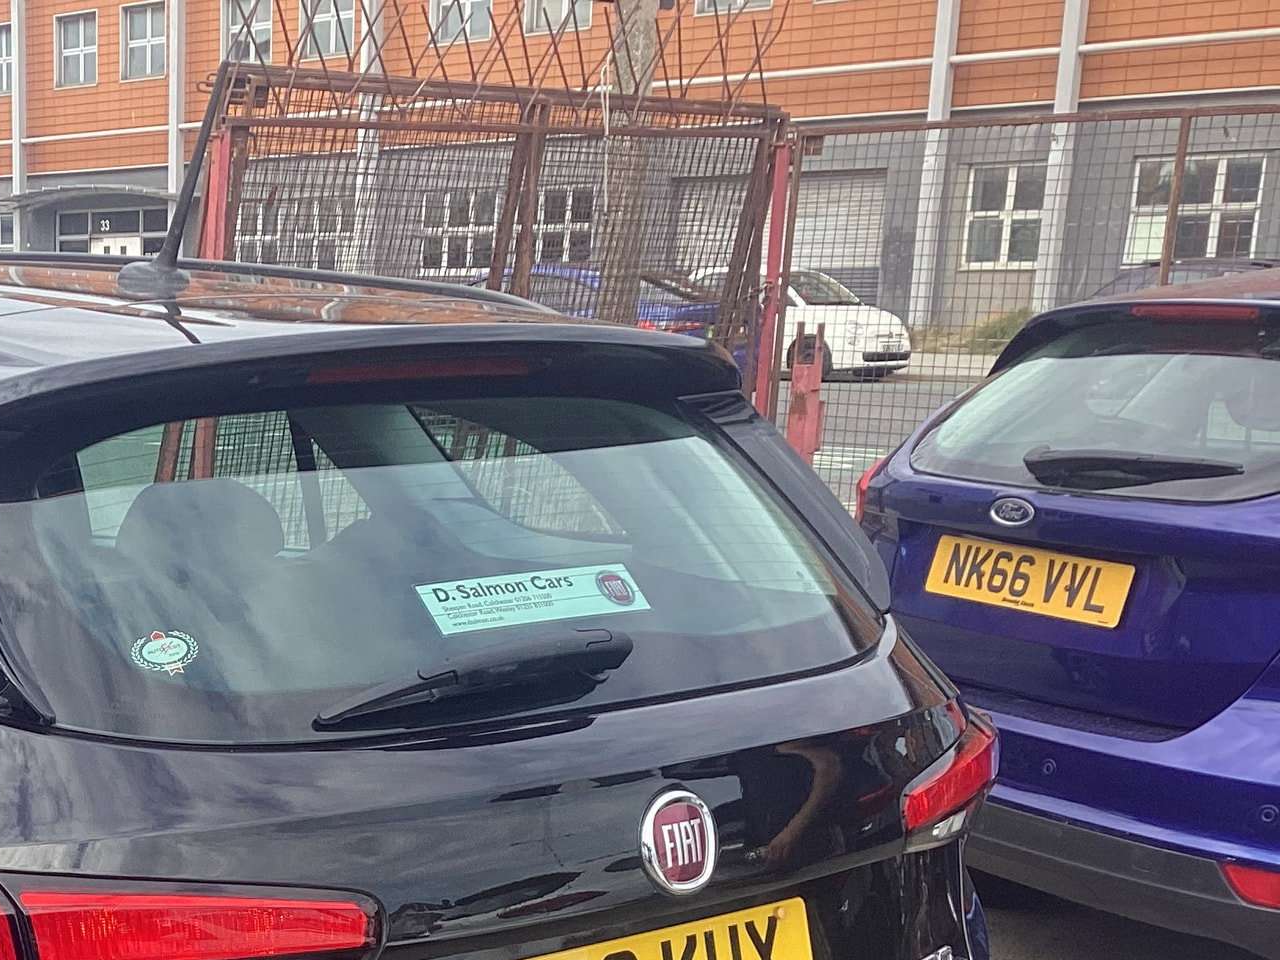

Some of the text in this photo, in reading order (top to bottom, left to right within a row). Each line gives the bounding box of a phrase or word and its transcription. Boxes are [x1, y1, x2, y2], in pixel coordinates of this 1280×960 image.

[100, 219, 110, 231] 33
[999, 502, 1024, 520] Ford
[432, 575, 574, 603] D. Salmon Cars
[943, 543, 1105, 614] NK66 VVL
[661, 818, 703, 868] FIAT
